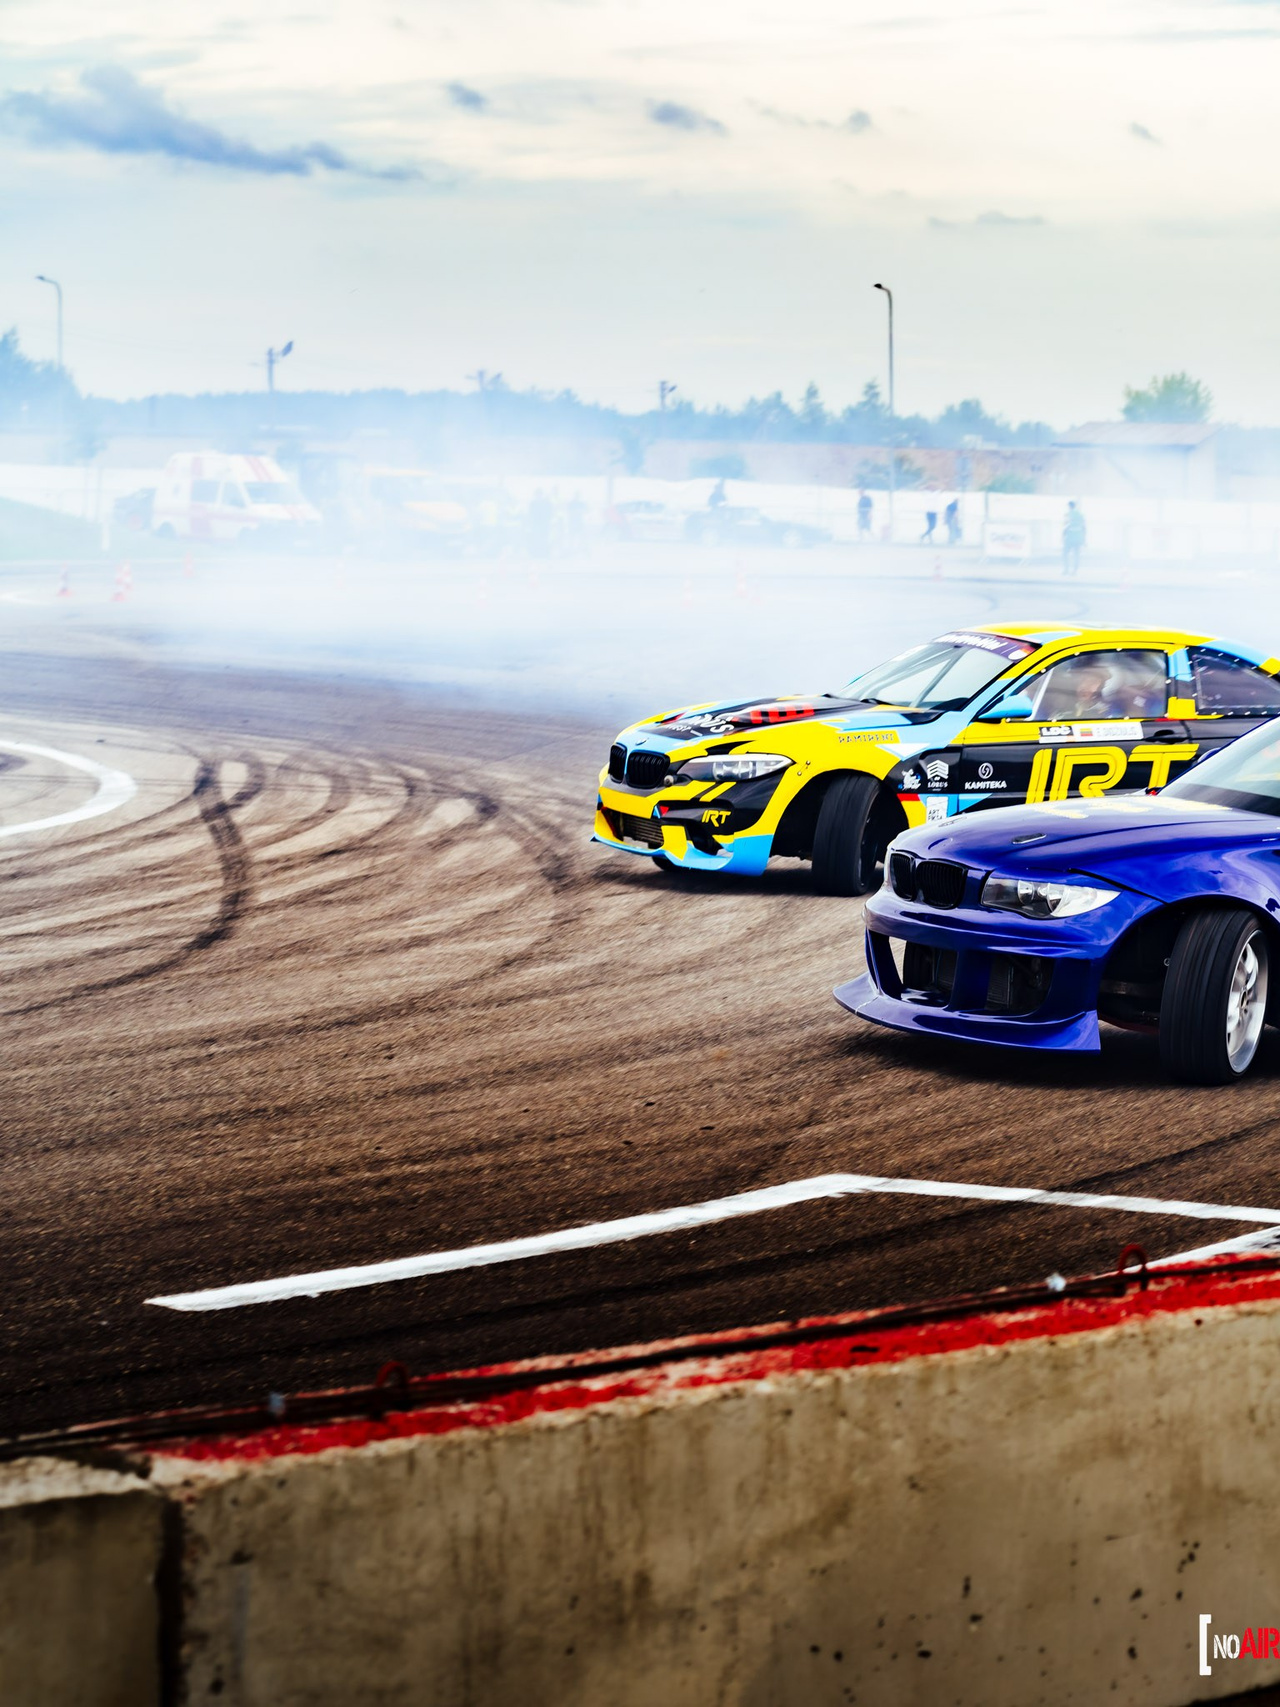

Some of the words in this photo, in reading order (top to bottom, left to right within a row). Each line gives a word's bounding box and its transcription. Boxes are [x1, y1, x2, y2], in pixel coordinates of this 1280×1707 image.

[1025, 744, 1200, 804] IRT
[964, 780, 1007, 790] KAMITEKA
[702, 809, 731, 827] IRT
